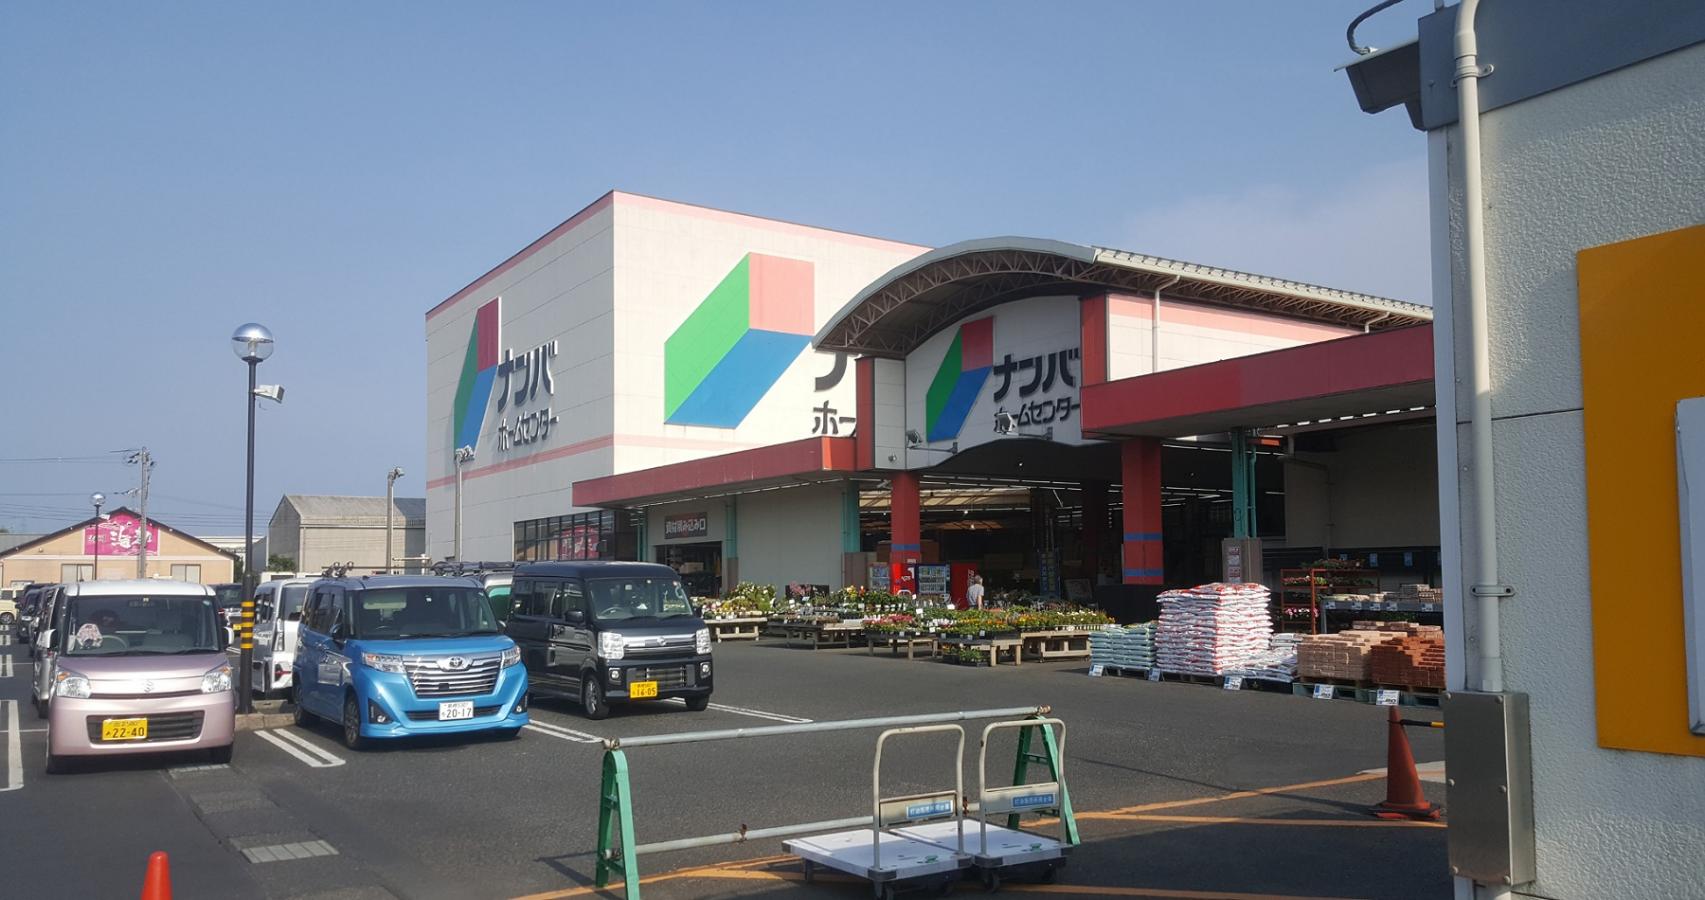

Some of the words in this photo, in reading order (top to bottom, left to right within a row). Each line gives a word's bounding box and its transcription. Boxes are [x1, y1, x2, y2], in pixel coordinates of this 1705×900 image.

[497, 340, 558, 413] ナンバ
[993, 348, 1079, 402] ナンバ
[498, 408, 560, 452] ホームセンター
[812, 400, 856, 435] ホー
